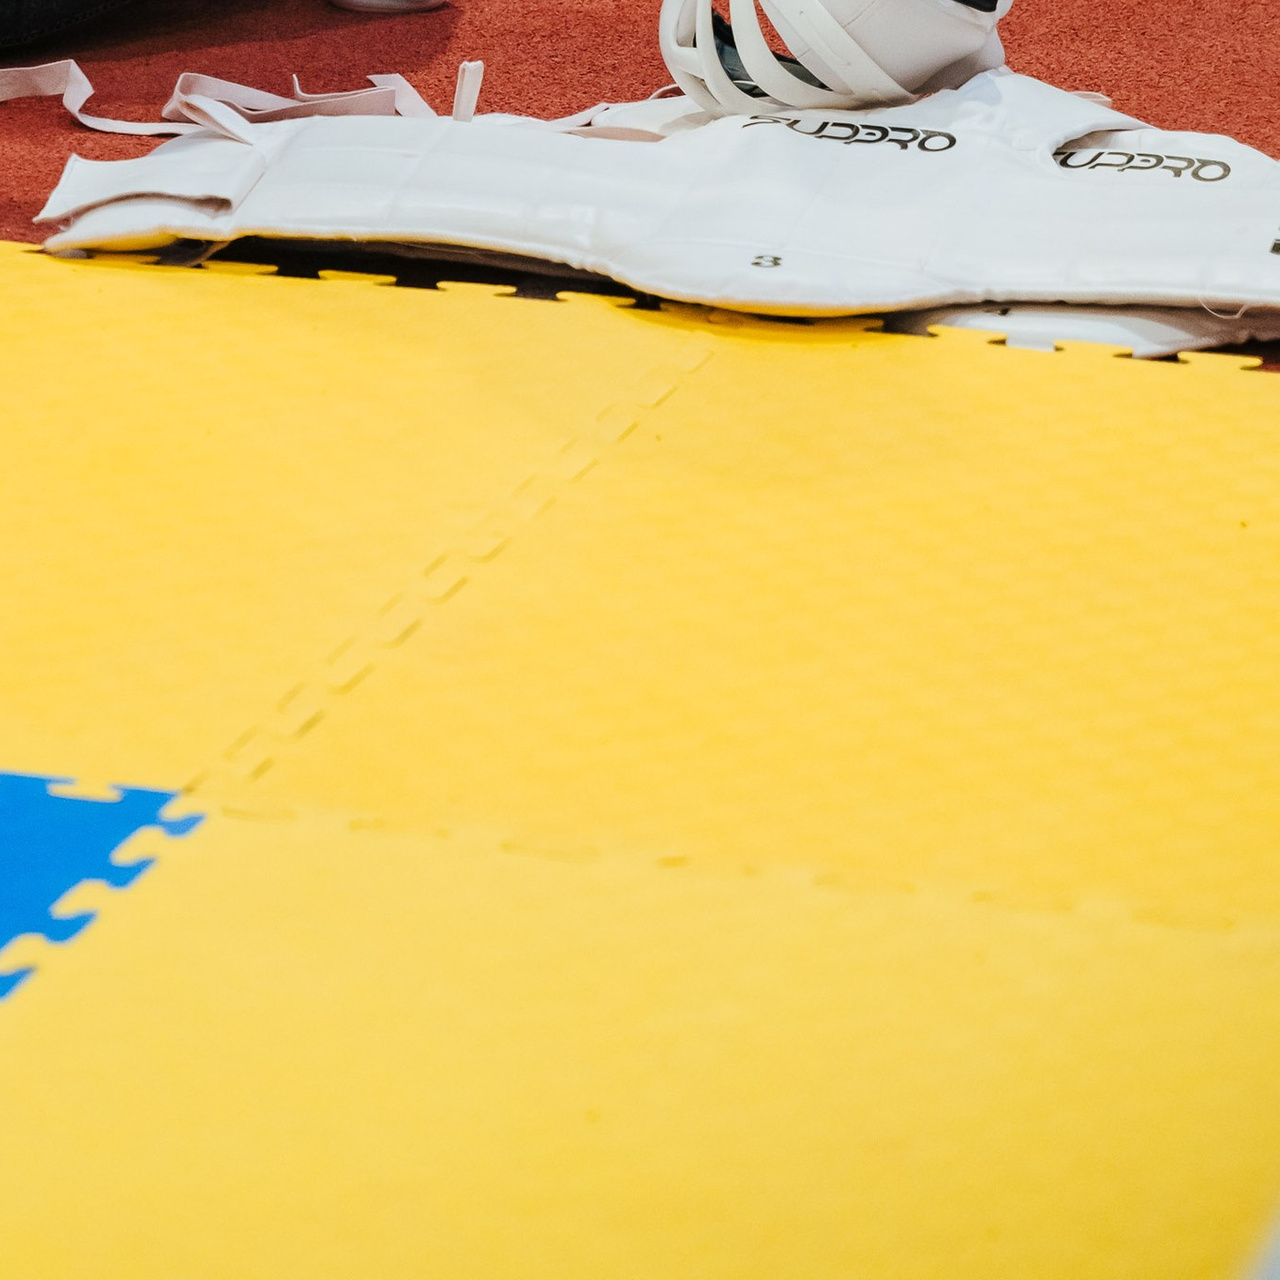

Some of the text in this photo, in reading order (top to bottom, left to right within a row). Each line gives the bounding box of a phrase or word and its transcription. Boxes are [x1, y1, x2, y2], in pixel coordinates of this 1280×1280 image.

[742, 114, 958, 153] SUPPRO
[1052, 151, 1231, 183] UPPRO
[751, 254, 783, 268] 3
